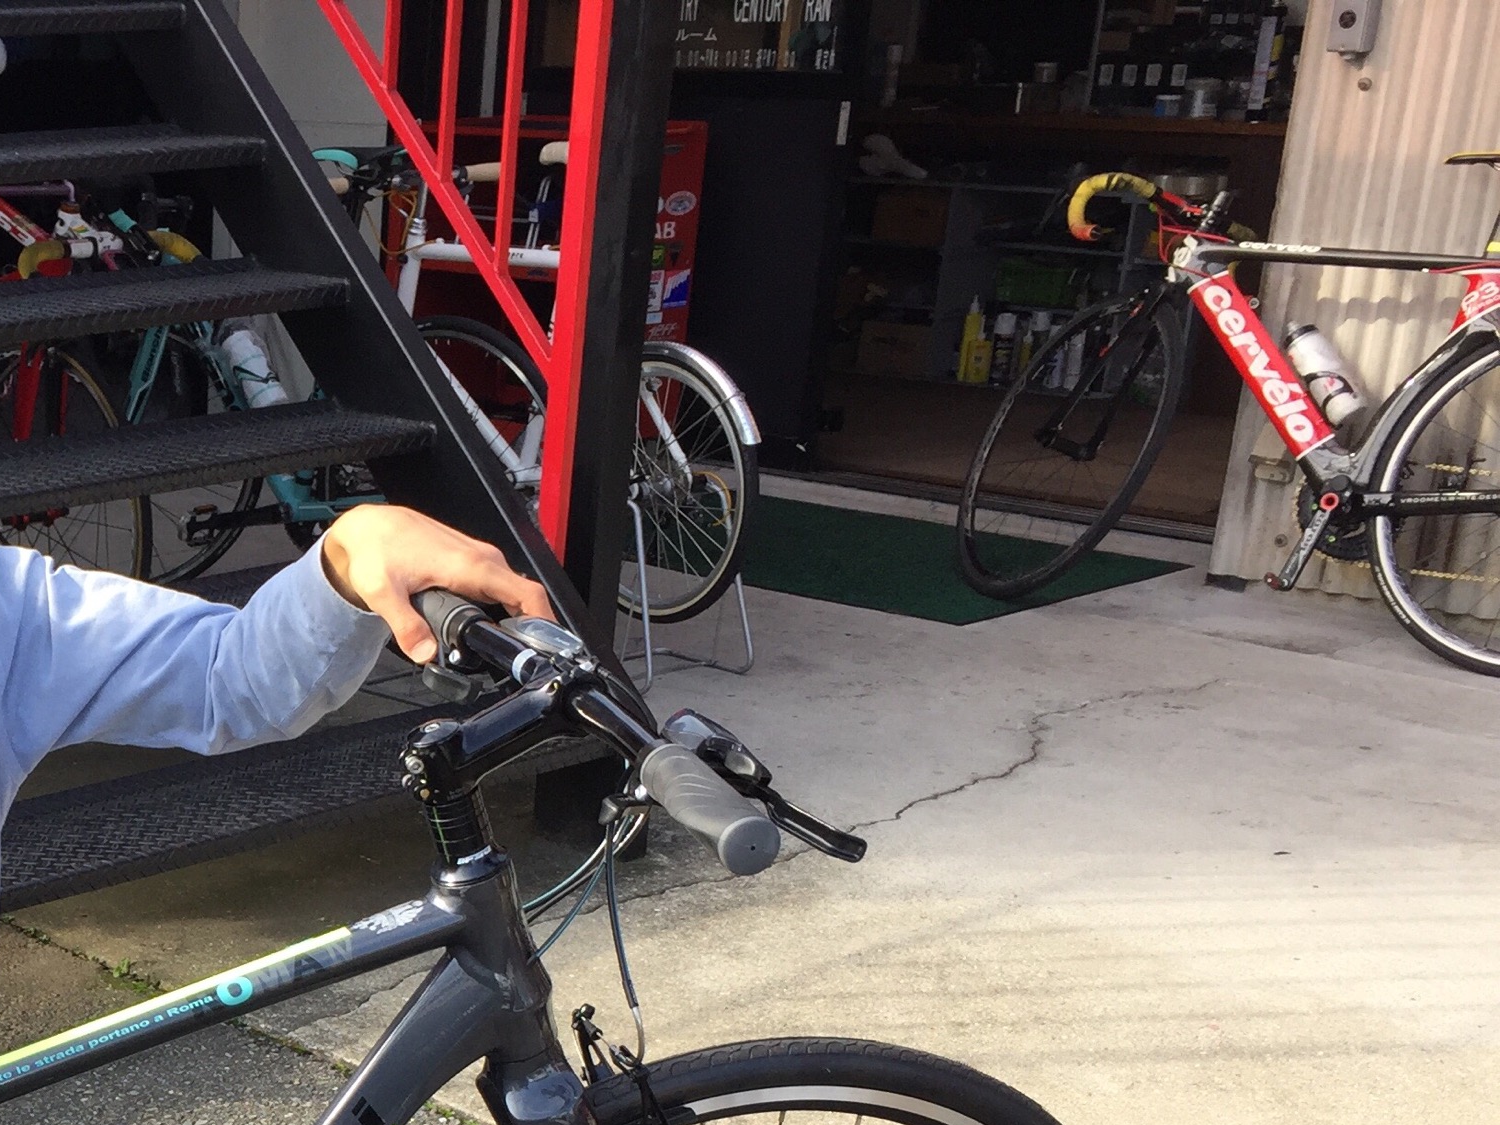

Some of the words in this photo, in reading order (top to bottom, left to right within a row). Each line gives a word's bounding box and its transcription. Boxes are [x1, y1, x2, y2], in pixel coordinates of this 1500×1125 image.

[34, 1043, 85, 1068] strada
[88, 1018, 150, 1050] portano
[153, 1013, 164, 1024] a
[166, 994, 214, 1019] Roma
